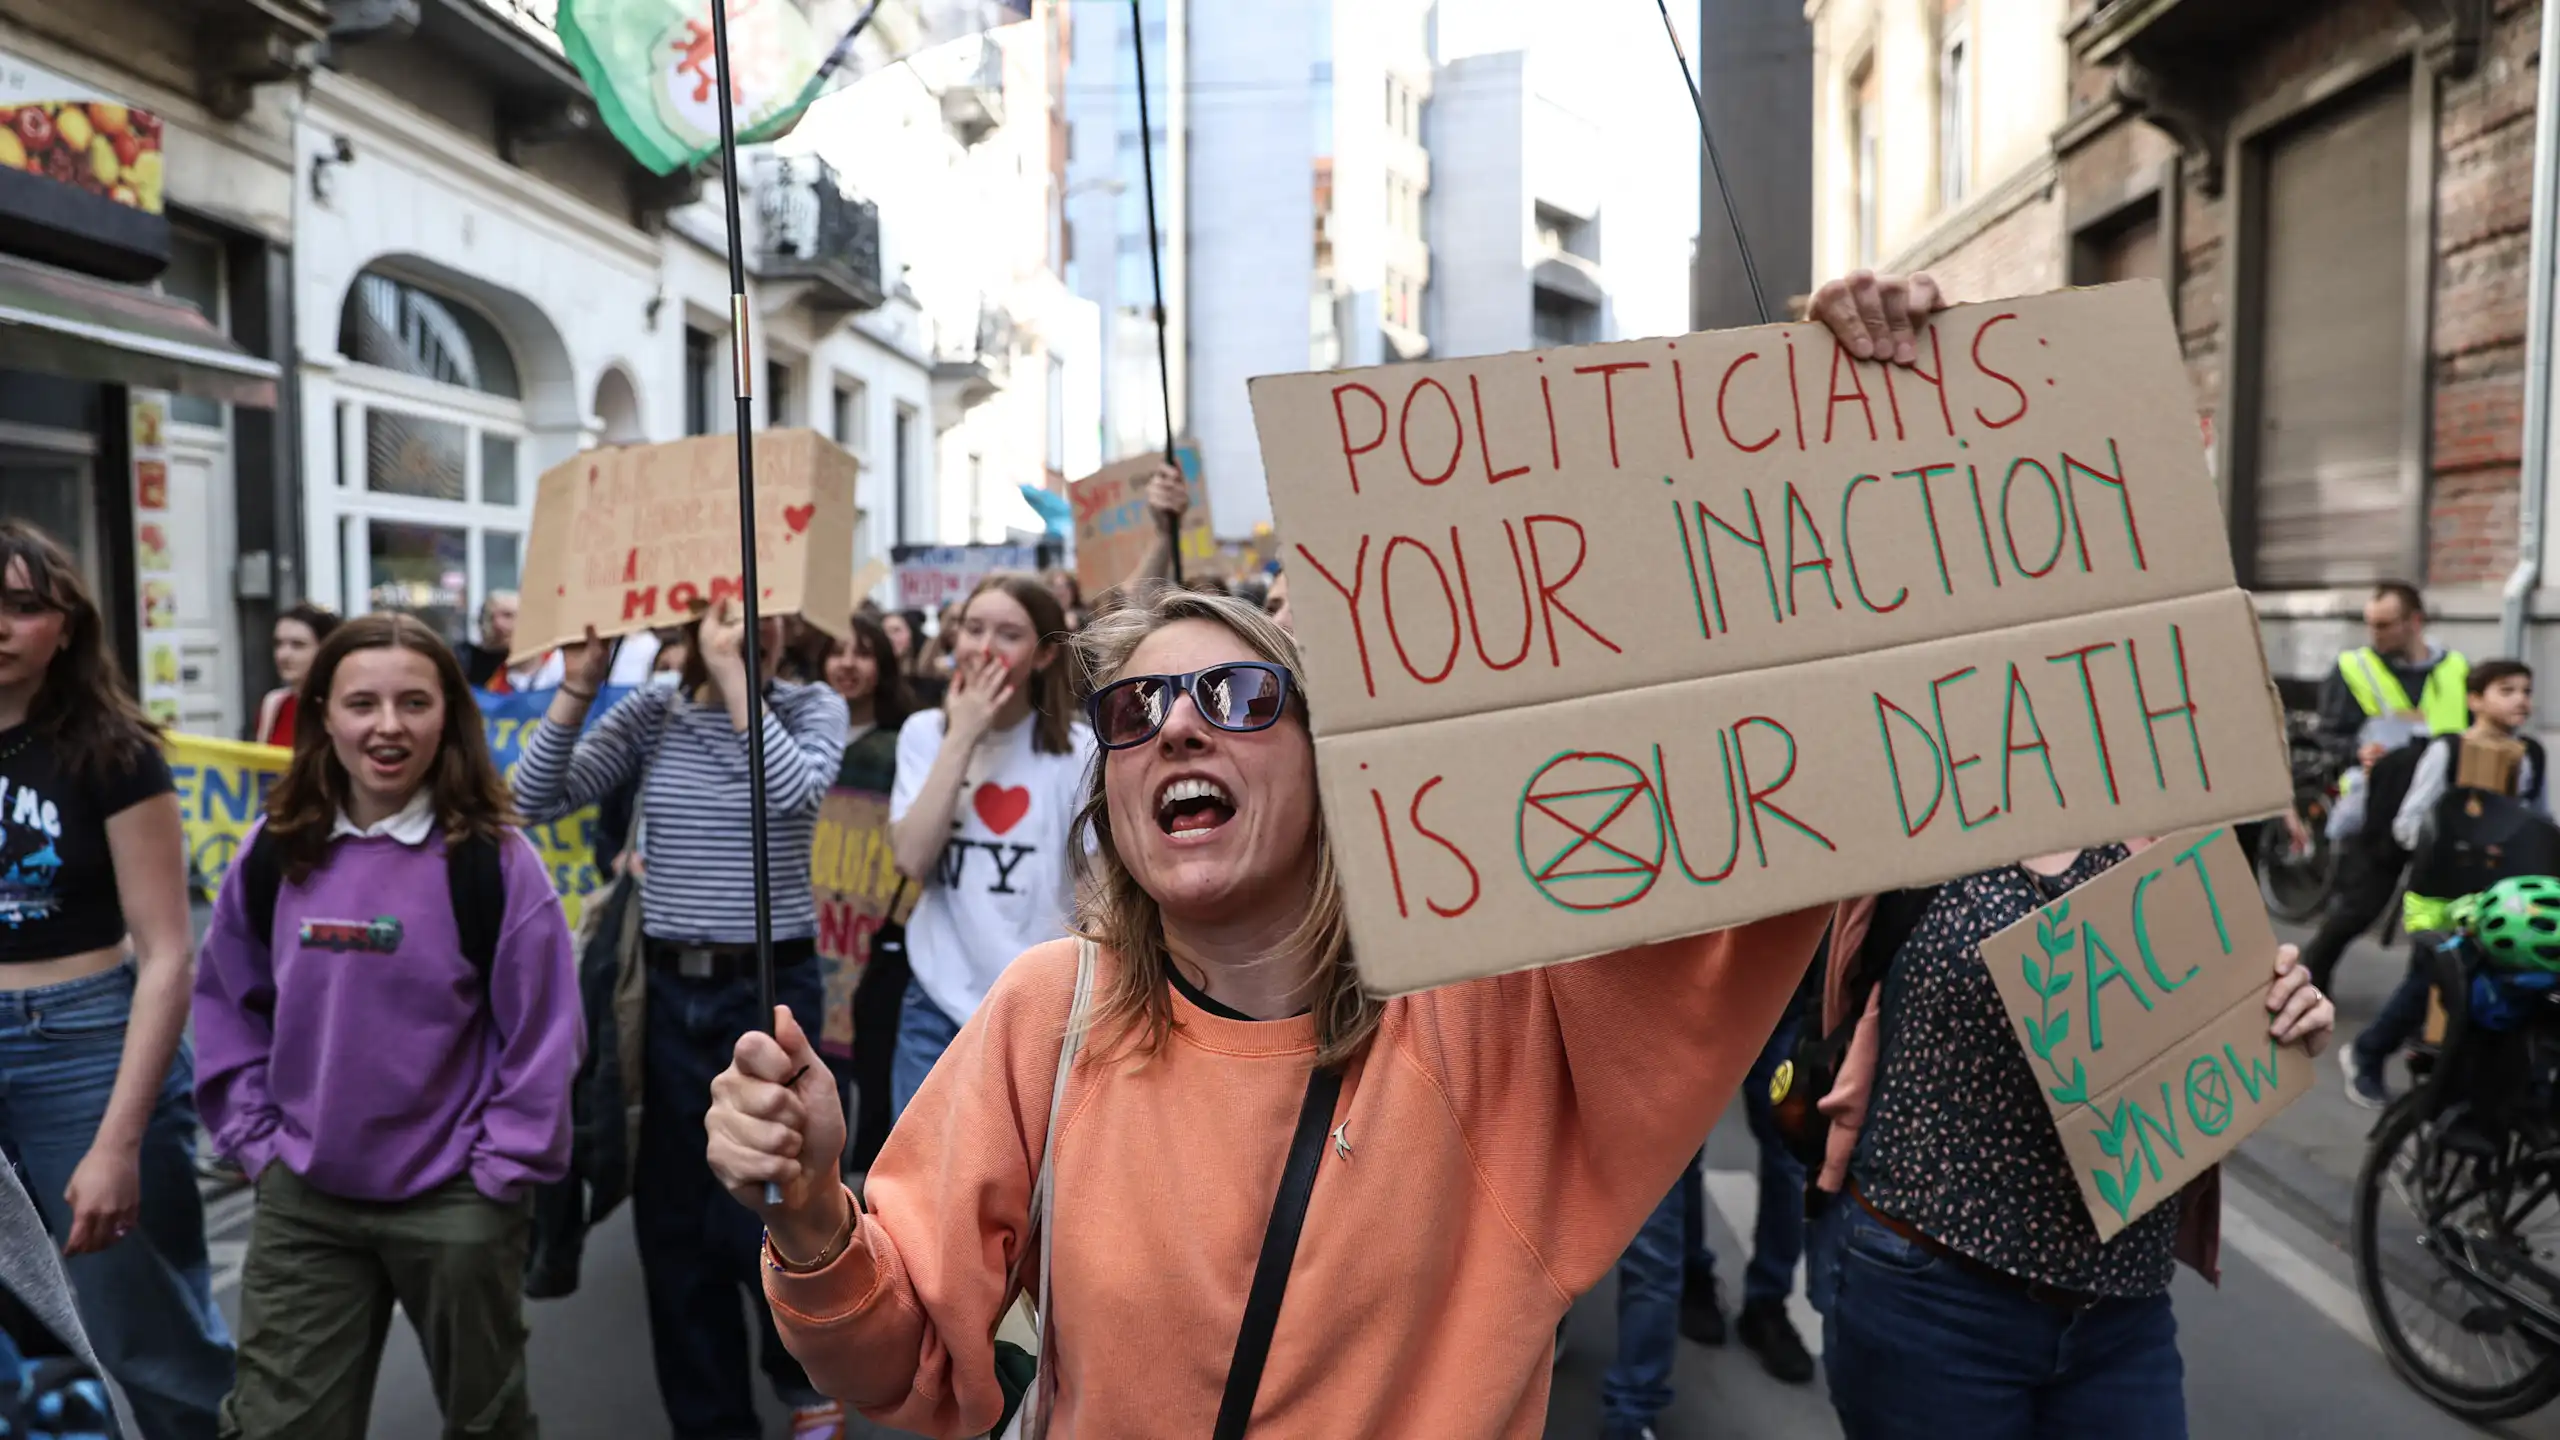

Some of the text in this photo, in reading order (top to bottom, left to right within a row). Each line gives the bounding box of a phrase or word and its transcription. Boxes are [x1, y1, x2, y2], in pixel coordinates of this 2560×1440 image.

[1296, 514, 1622, 698] YOUR
[1872, 624, 2211, 838] DEATH
[2081, 827, 2233, 1052] ACT
[2128, 1012, 2279, 1182] NOW
